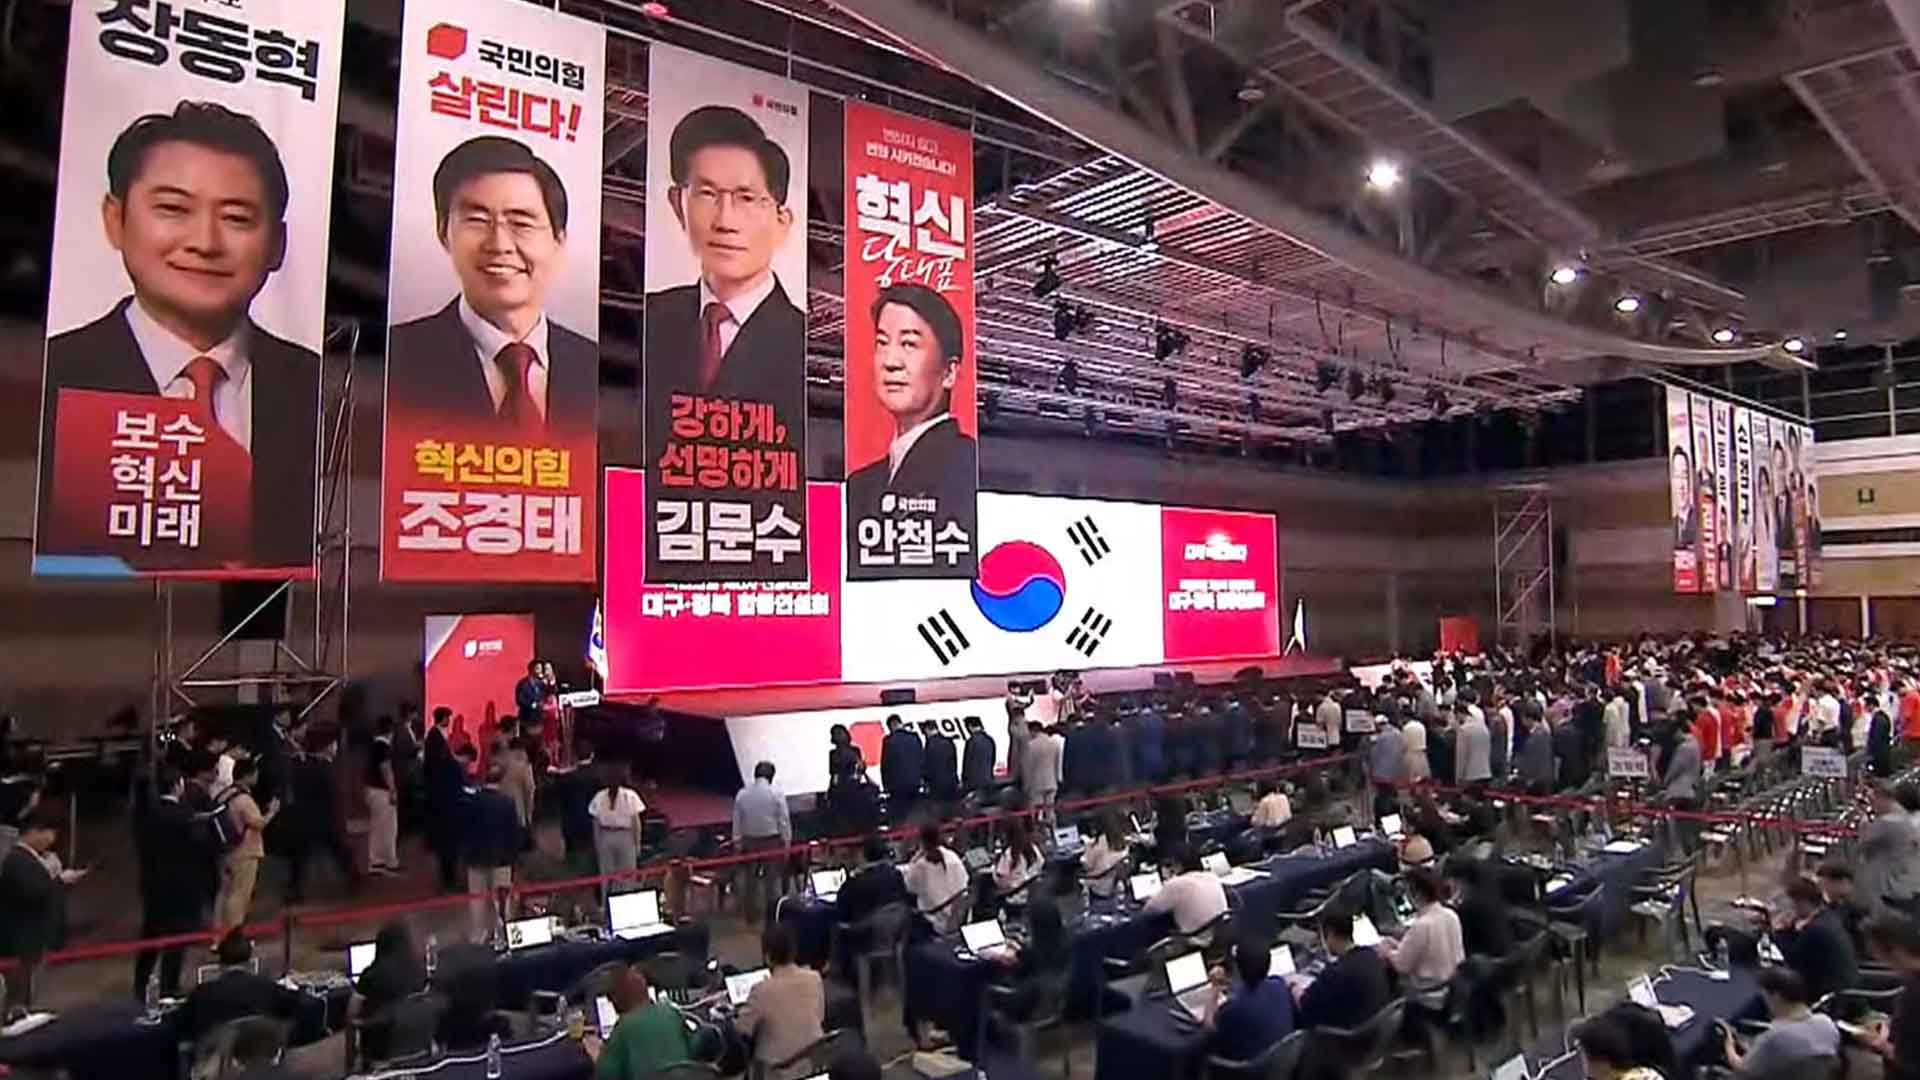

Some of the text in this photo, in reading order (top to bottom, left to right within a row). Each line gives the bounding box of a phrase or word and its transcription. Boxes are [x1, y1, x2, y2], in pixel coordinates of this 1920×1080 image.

[97, 0, 319, 101] 장동혁
[479, 40, 585, 90] 국민의힘
[427, 71, 582, 142] 살린다!
[856, 174, 966, 261] 혁신
[112, 411, 206, 456] 보수
[671, 394, 787, 444] 강하게,
[111, 454, 201, 501] 혁신
[415, 439, 570, 488] 혁신의힘
[659, 443, 798, 492] 선명하게
[109, 502, 201, 548] 미래
[398, 490, 582, 556] 조경태
[656, 500, 802, 564] 김문수
[857, 517, 971, 567] 안철수
